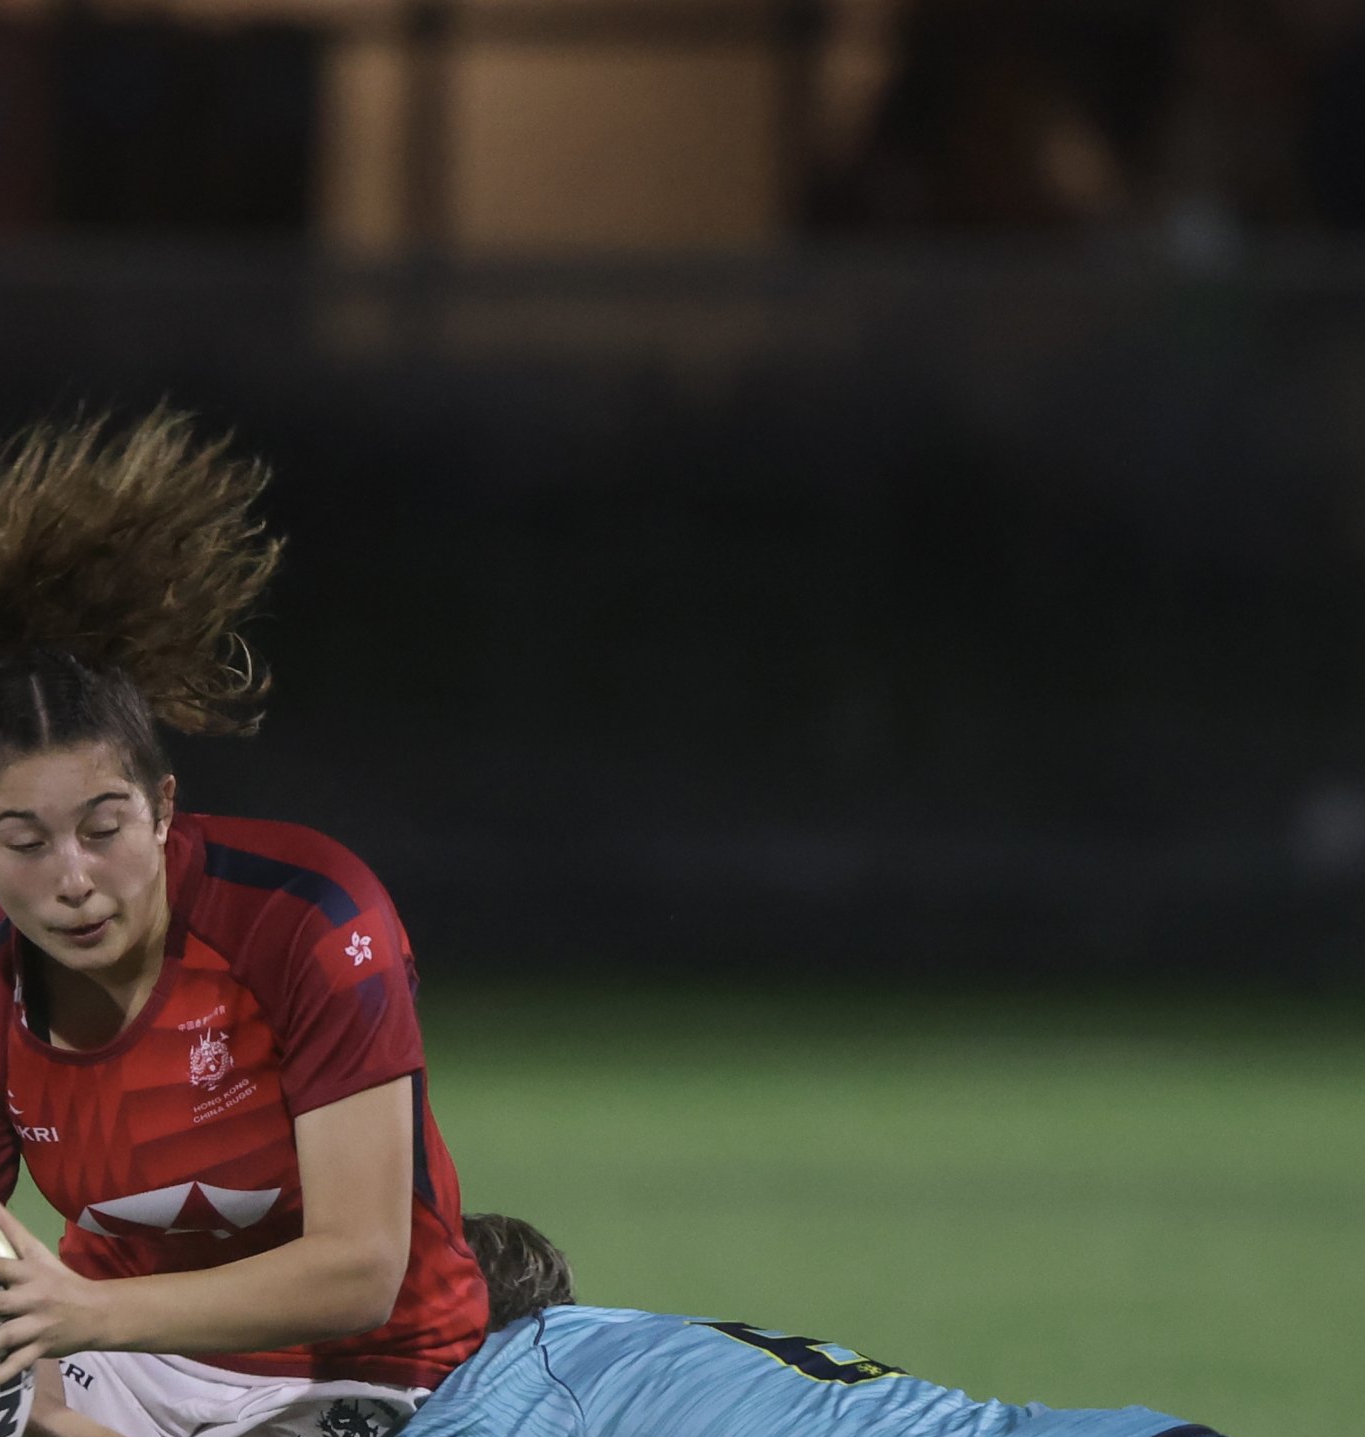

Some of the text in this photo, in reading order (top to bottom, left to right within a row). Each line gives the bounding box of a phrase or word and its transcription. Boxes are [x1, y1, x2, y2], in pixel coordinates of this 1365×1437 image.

[193, 1079, 249, 1112] HONG KONG
[193, 1084, 257, 1123] CHINA RUGBY
